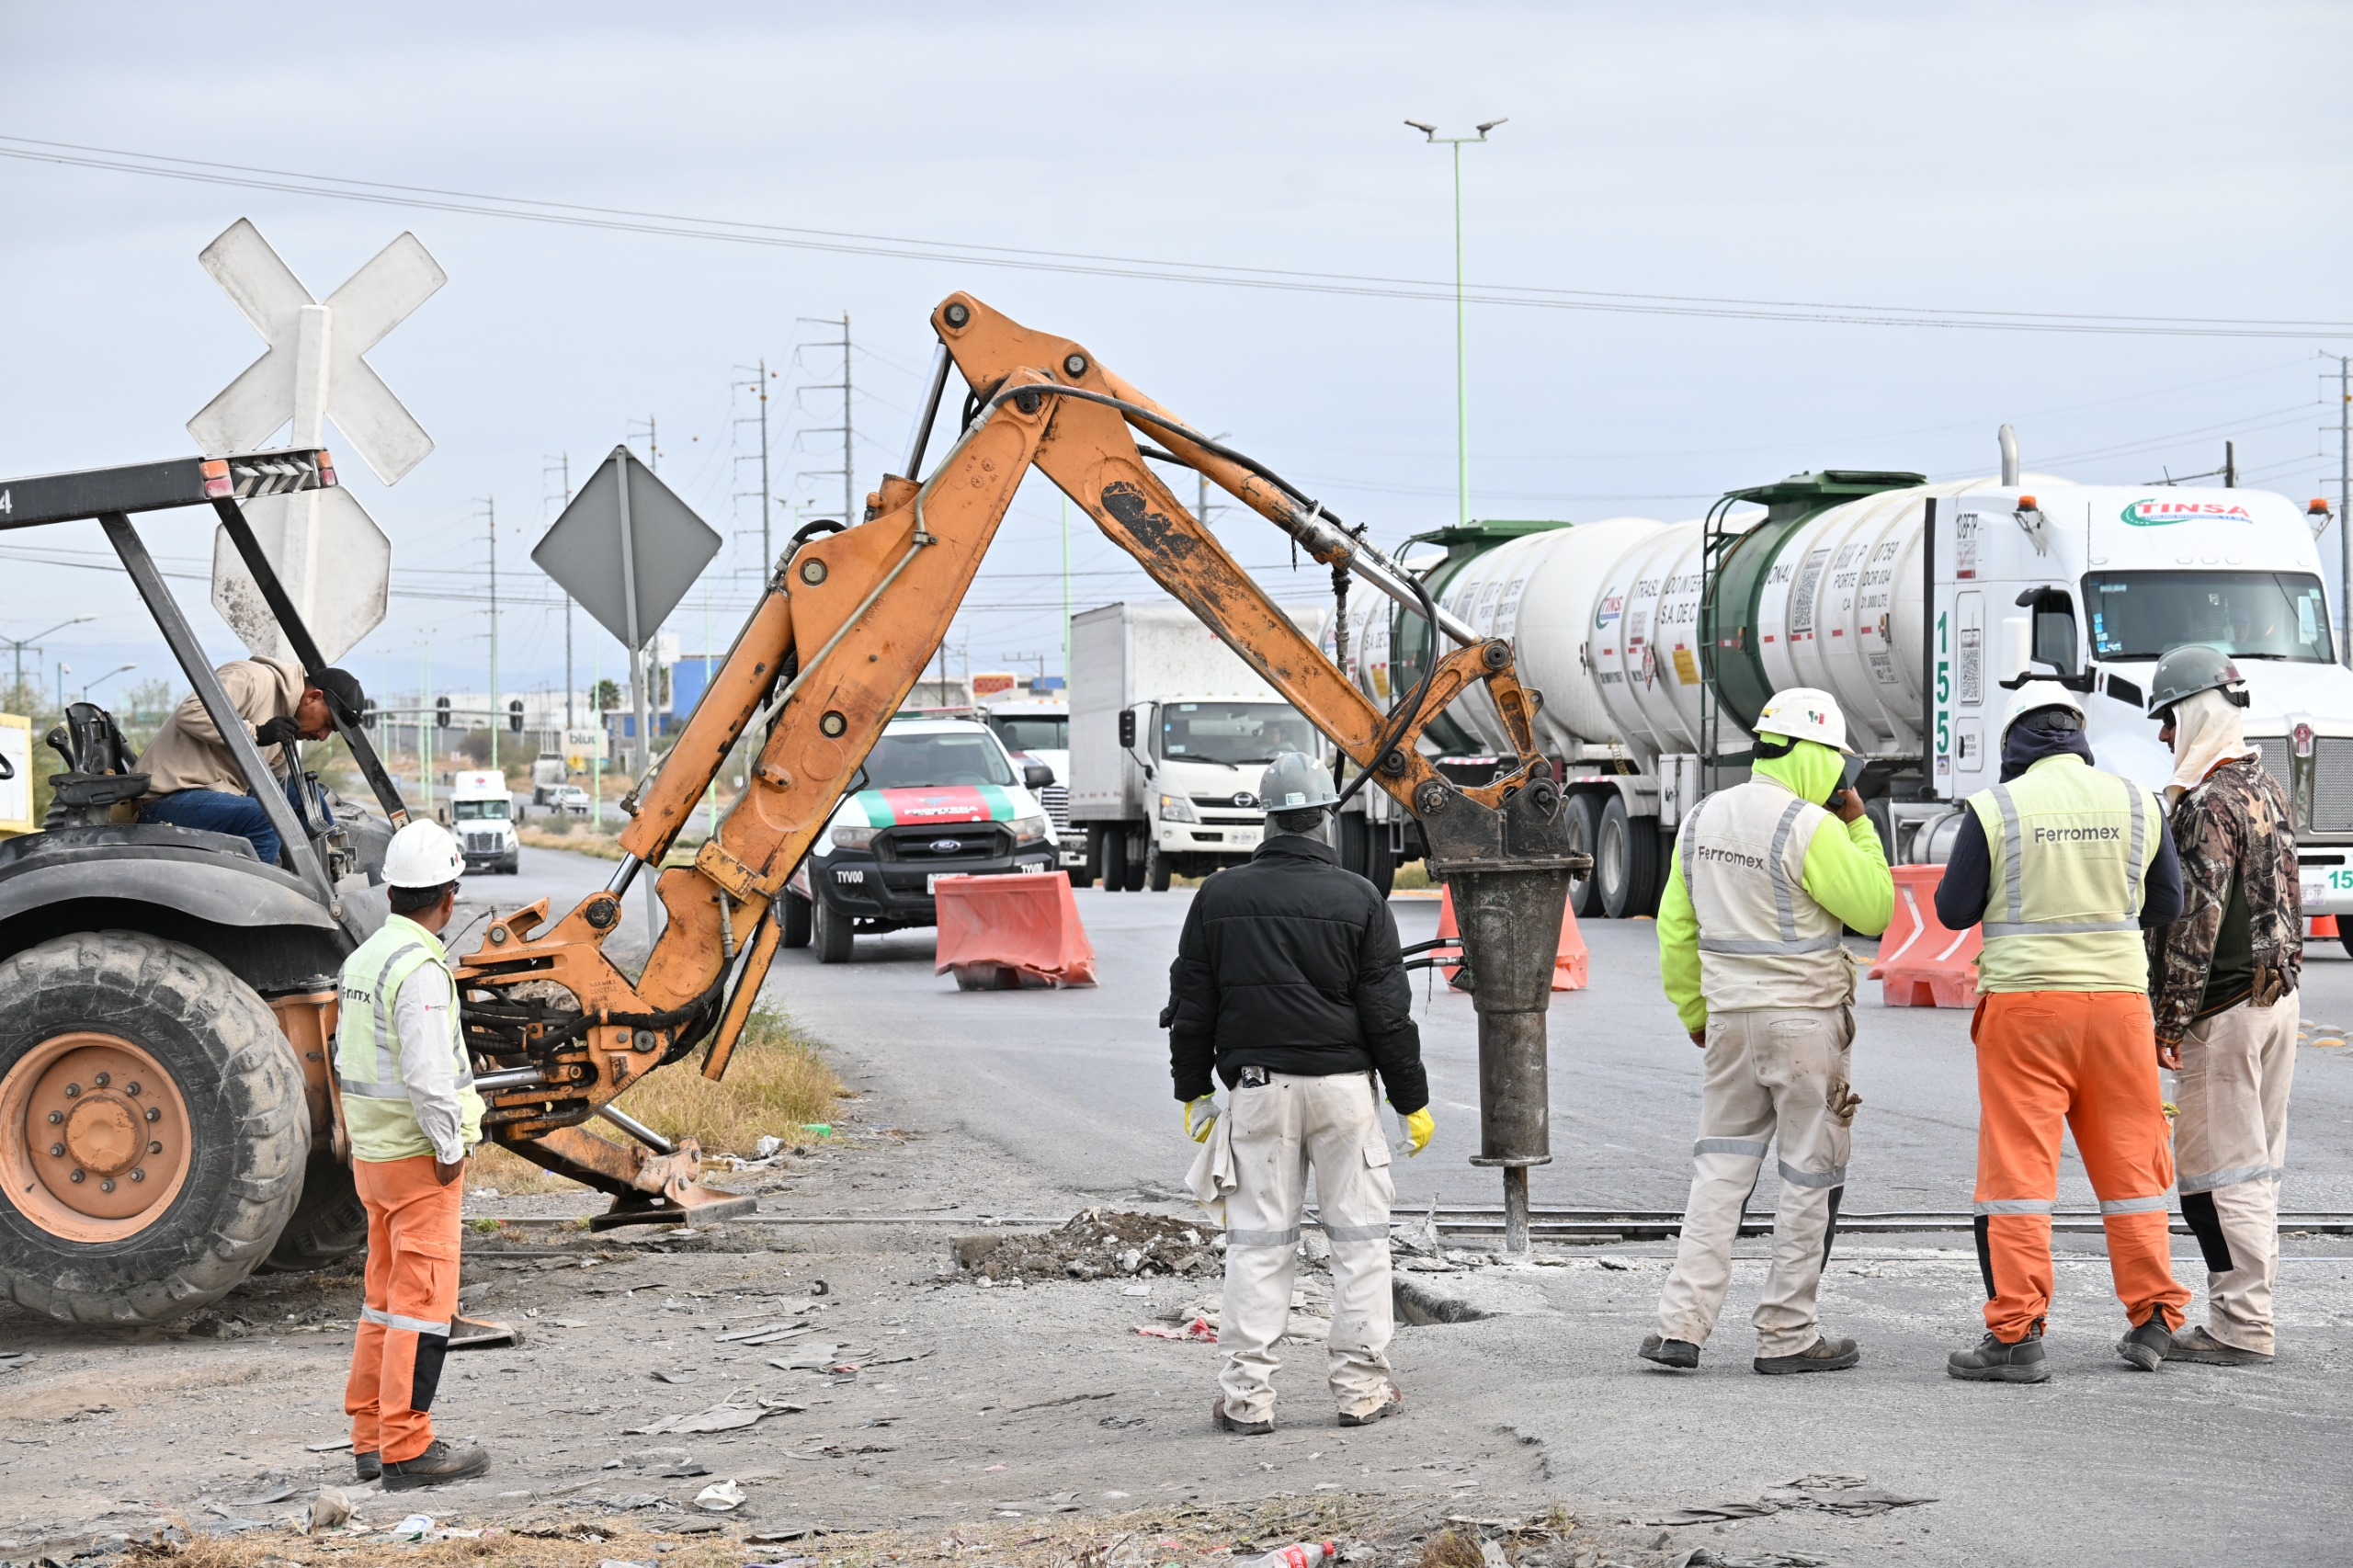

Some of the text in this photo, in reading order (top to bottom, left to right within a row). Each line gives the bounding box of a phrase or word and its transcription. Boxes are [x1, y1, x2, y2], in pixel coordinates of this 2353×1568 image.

[2137, 504, 2250, 517] TINSA
[1677, 603, 1689, 623] DE
[975, 679, 1013, 692] OXXO
[904, 806, 978, 816] FRONTERA
[2035, 827, 2120, 843] Ferromex
[1699, 846, 1764, 869] Ferromex
